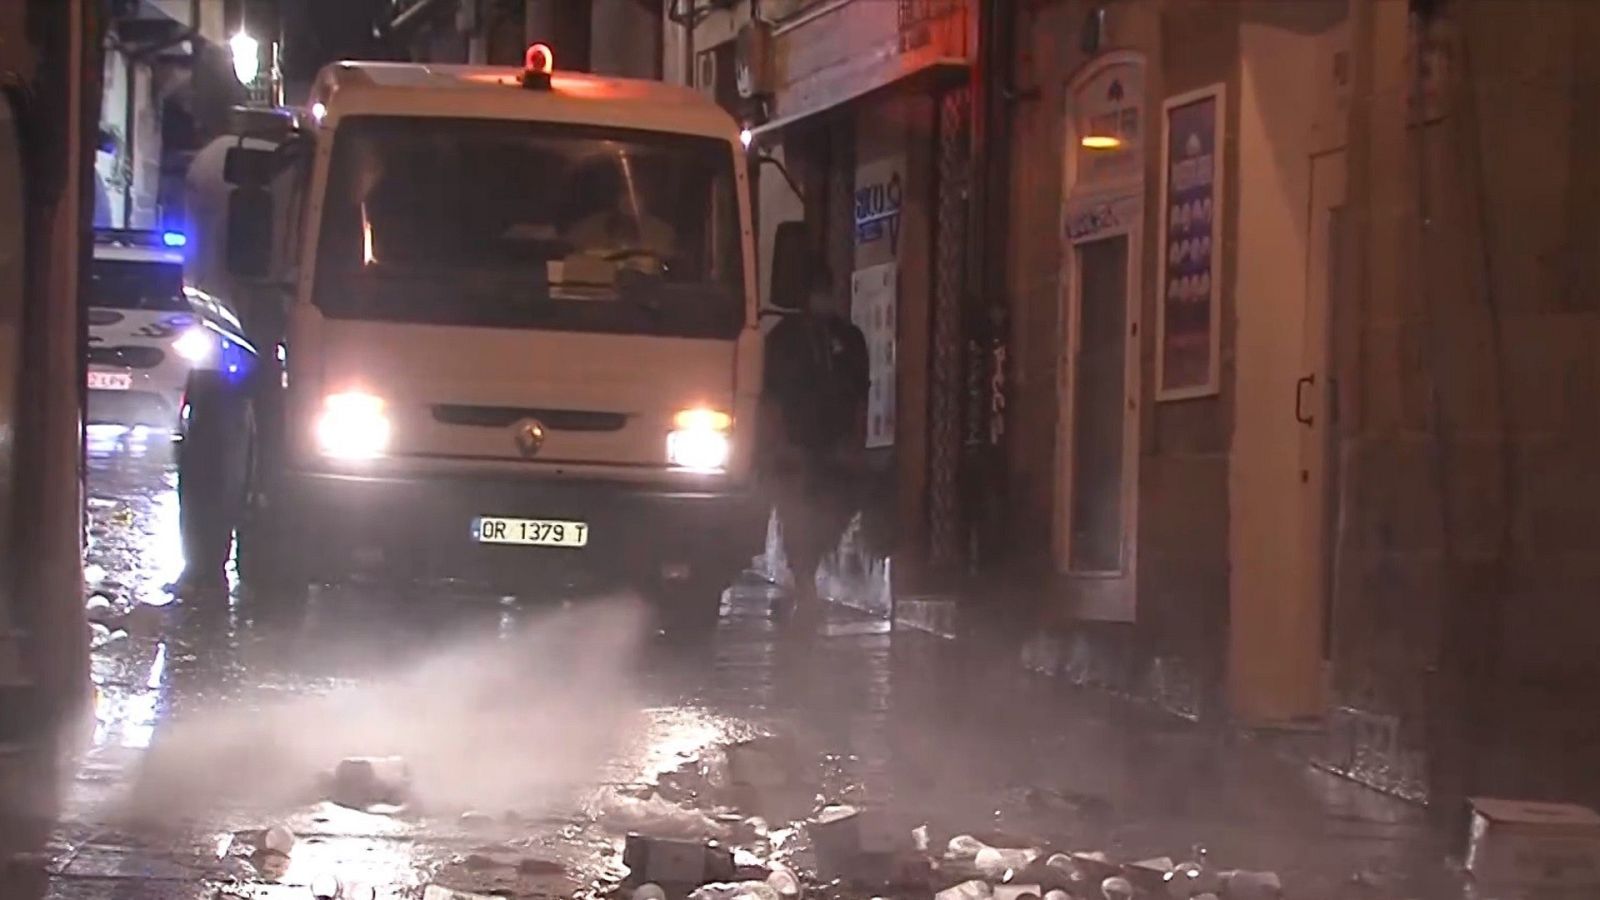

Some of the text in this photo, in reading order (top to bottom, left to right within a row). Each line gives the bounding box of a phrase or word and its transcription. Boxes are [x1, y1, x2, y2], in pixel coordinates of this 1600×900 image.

[483, 521, 585, 542] OR 1379 T
